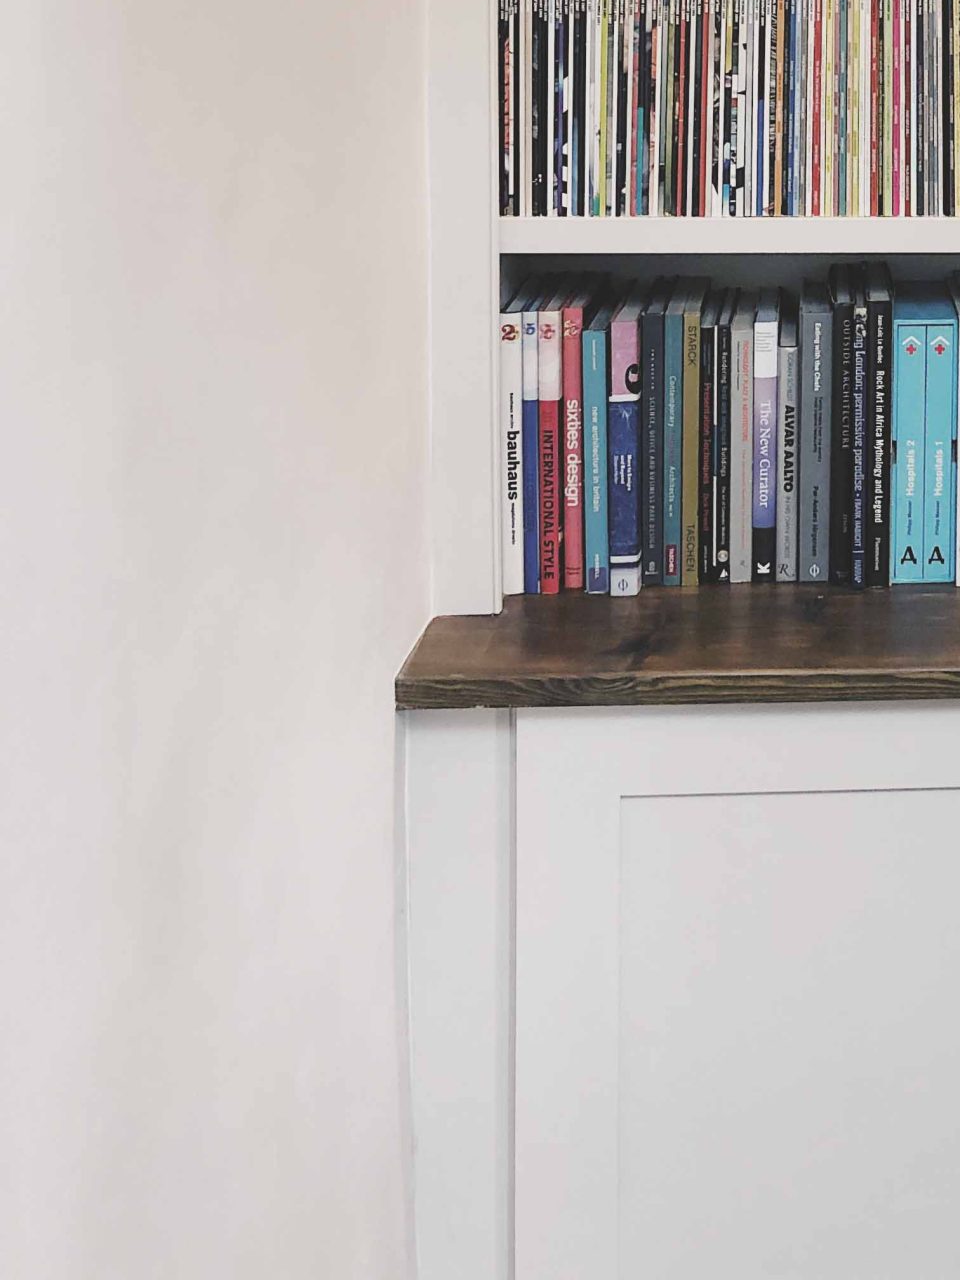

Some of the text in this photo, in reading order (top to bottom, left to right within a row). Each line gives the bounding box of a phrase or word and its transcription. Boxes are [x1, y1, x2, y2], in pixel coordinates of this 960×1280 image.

[688, 325, 697, 366] STARCK
[813, 322, 822, 344] Eating
[813, 345, 822, 358] with
[813, 371, 822, 392] Chefs
[841, 319, 850, 449] OUTSIDE ARCHITECTURE
[875, 370, 884, 390] Rock
[875, 391, 884, 404] Art
[667, 375, 677, 502] Contemporary Architects
[853, 392, 864, 447] permissive
[875, 414, 884, 437] Africa
[507, 429, 520, 501] bauhaus
[564, 399, 582, 507] sixties design
[593, 425, 601, 474] architecture
[759, 400, 772, 508] The New Curator
[784, 404, 795, 493] ALVAR AALTO
[872, 439, 884, 476] Mythology
[593, 475, 601, 484] in
[853, 449, 864, 492] paradise
[874, 477, 884, 493] and
[905, 447, 916, 496] Hospitals
[933, 447, 944, 496] Hospitals
[543, 429, 555, 580] INTERNATIONAL STYLE
[593, 486, 601, 512] britain
[872, 495, 884, 523] Legend
[686, 524, 695, 572] TASCHEN
